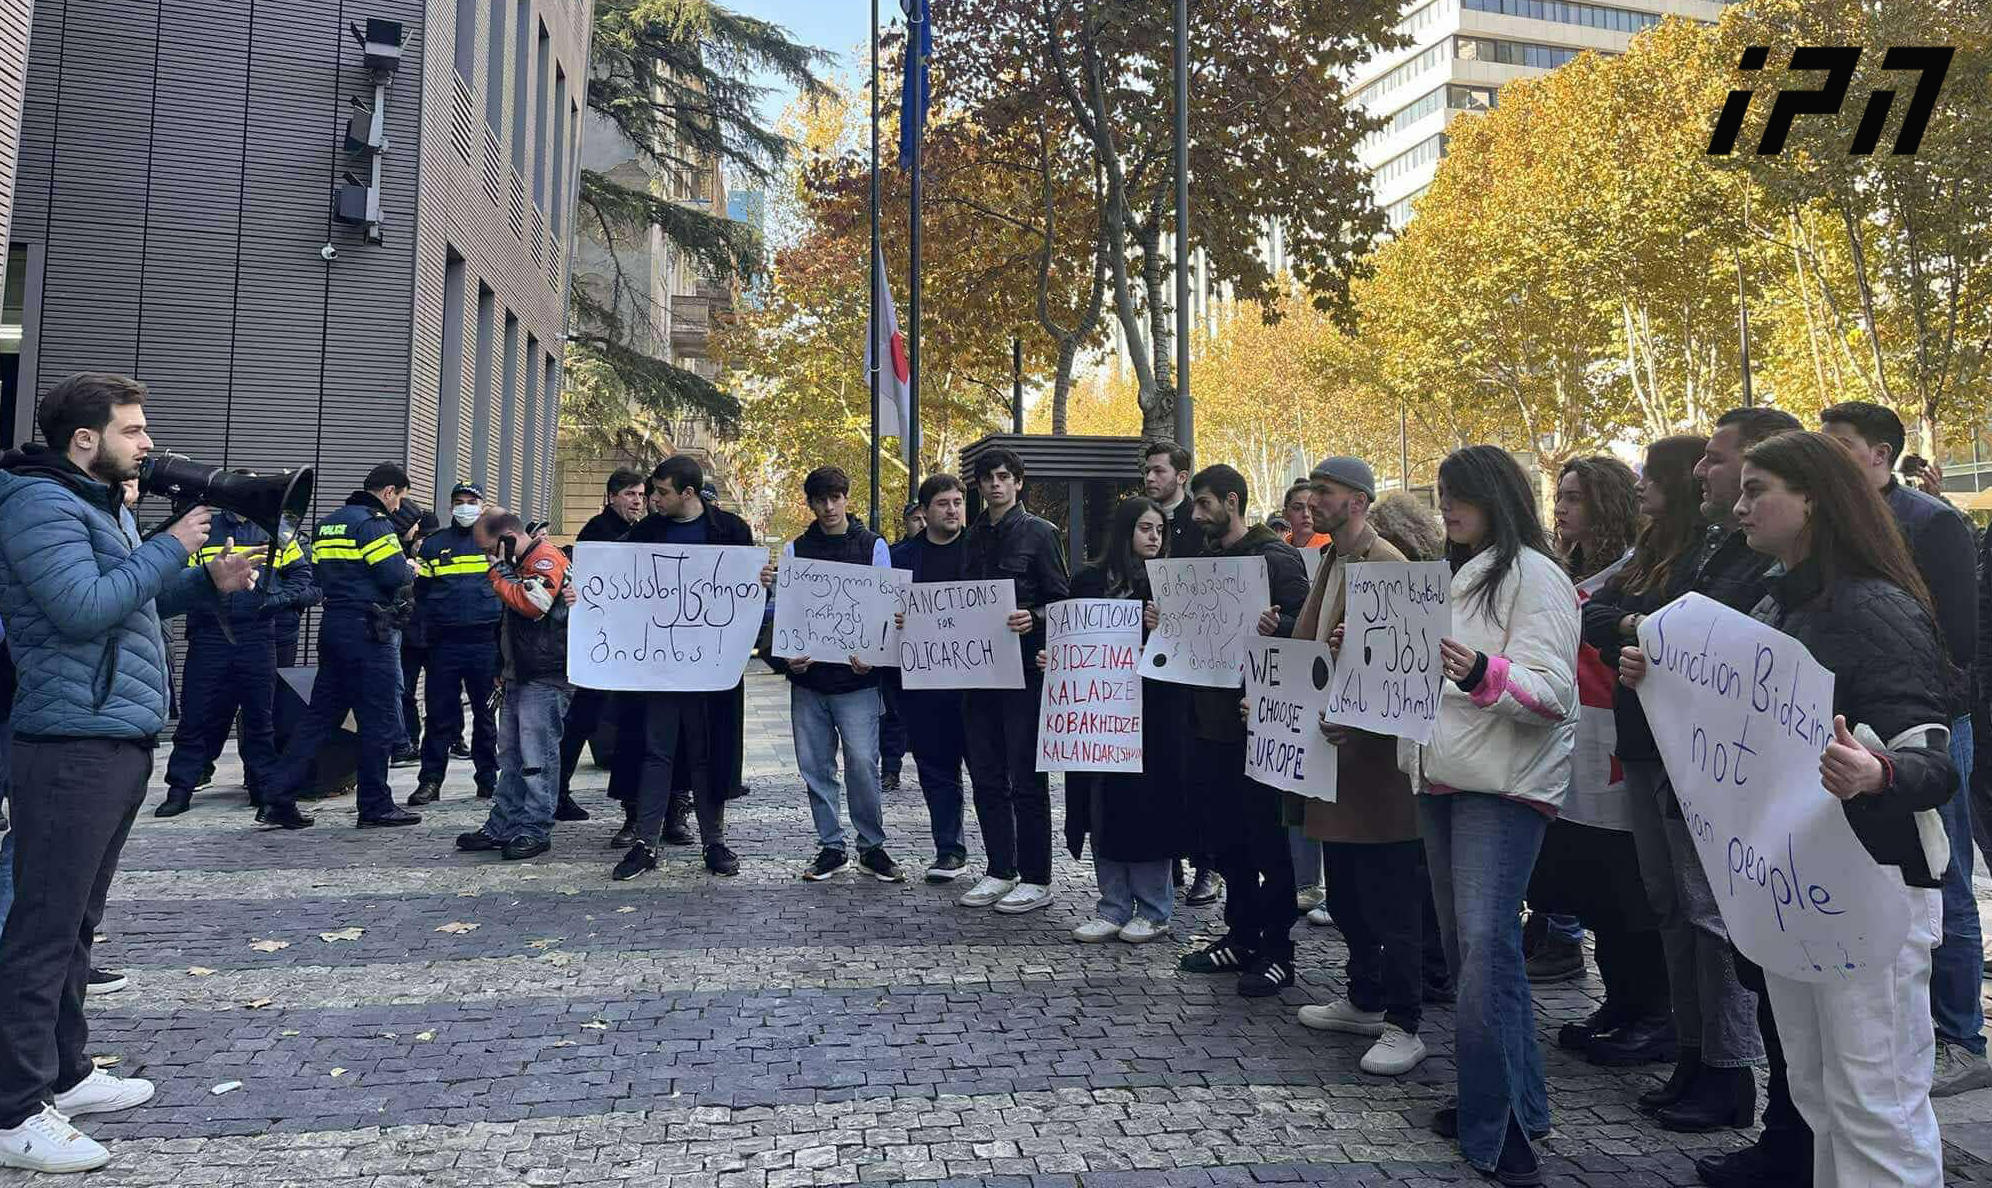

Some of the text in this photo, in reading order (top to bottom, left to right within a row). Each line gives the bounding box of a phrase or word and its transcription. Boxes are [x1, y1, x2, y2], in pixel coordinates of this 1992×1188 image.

[900, 585, 997, 616] SANCTIONS
[937, 616, 956, 630] FOR
[1048, 604, 1141, 637] SANCTIONS
[1050, 644, 1135, 672] BIDZINA
[1248, 648, 1281, 686] WE
[1047, 680, 1137, 707] KALADZE
[1046, 712, 1140, 735] KOBAKHIDZE
[1258, 696, 1303, 733] CHOOSE
[1692, 714, 1757, 786] not
[1728, 832, 1847, 932] people
